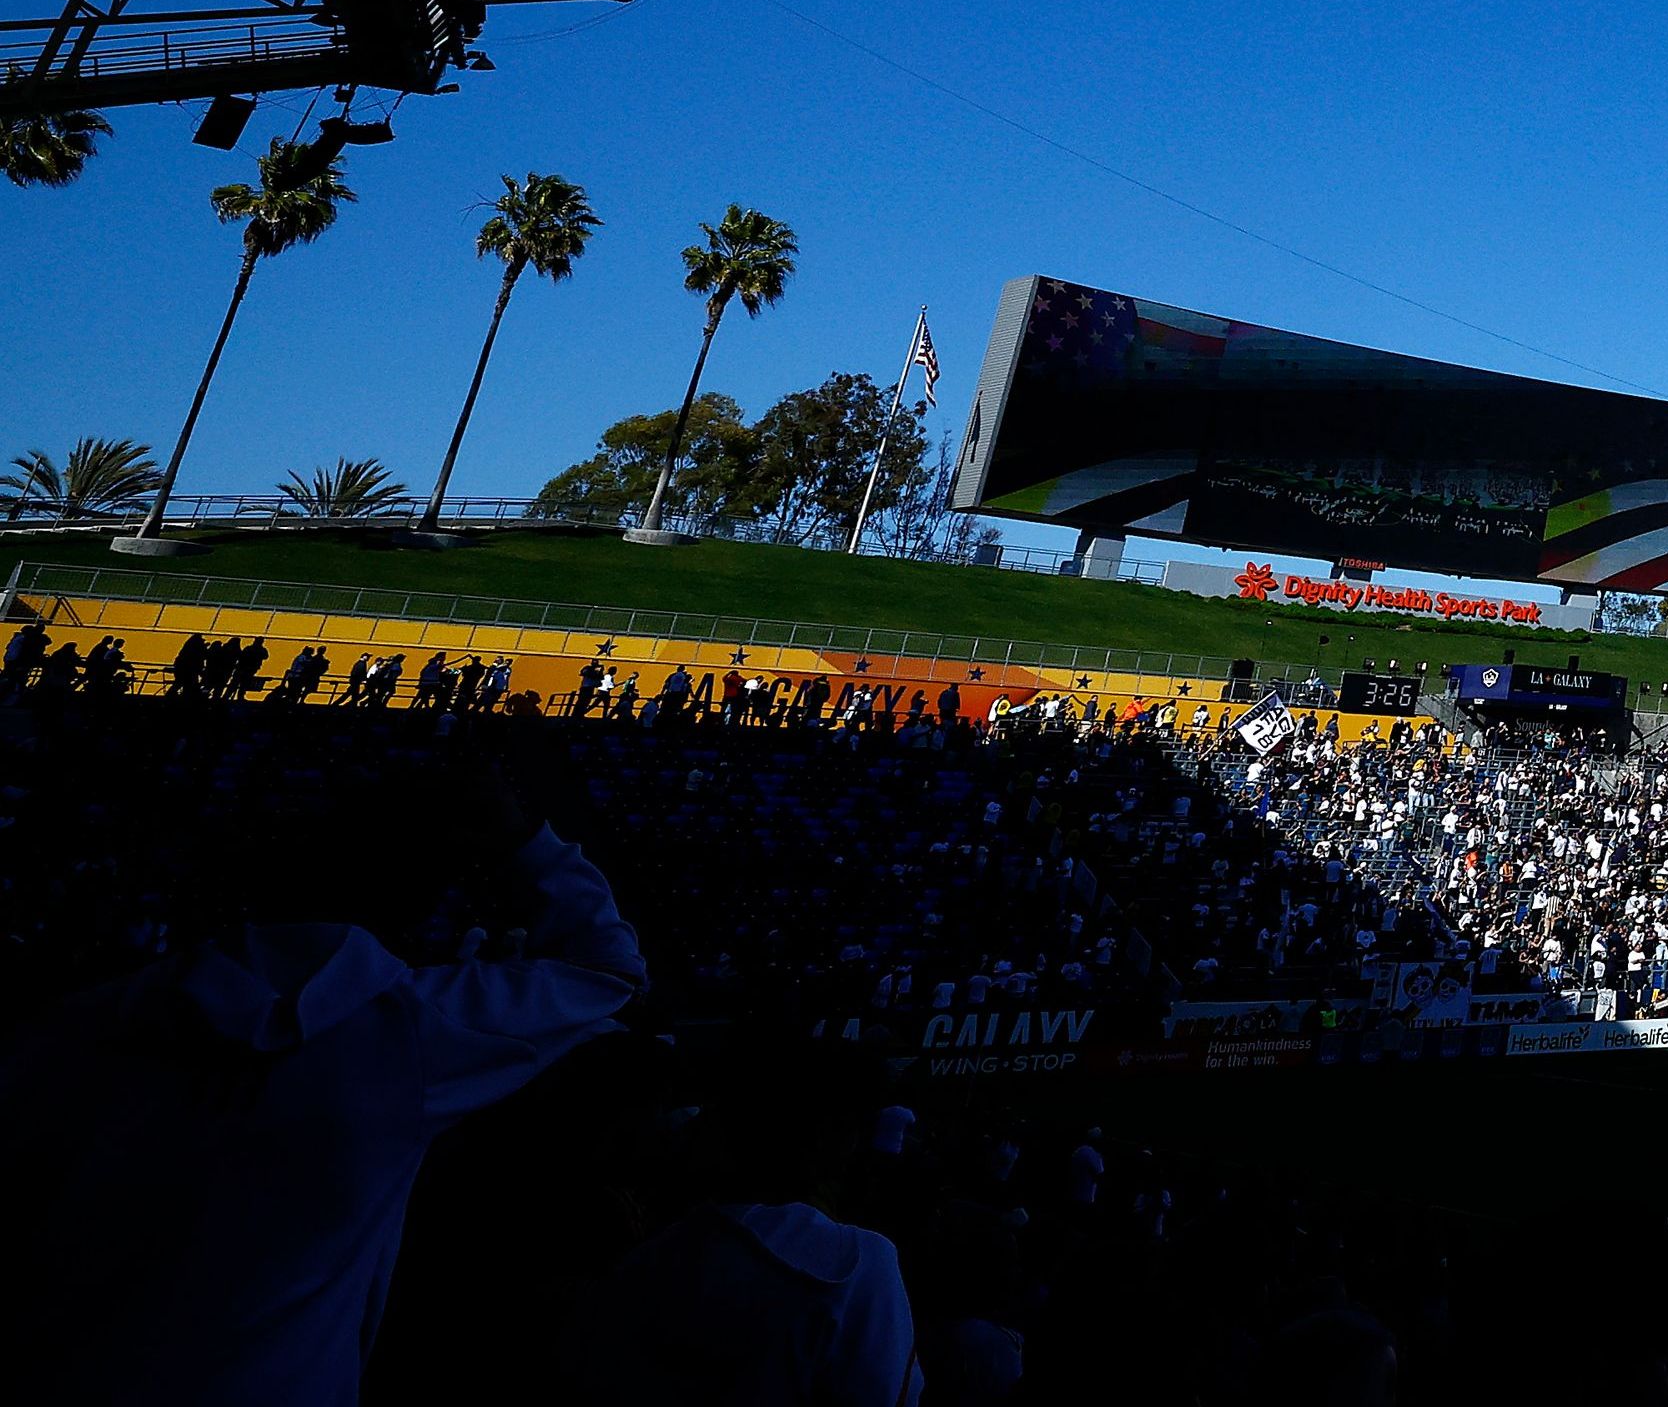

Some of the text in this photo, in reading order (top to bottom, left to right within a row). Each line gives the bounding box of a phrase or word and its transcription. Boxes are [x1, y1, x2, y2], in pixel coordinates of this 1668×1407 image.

[1343, 557, 1386, 571] TOSHIBA
[1284, 576, 1542, 624] Dignity Health Sports Park
[1531, 671, 1593, 689] LA GALAXY
[1366, 682, 1412, 707] 3:26
[1208, 1039, 1313, 1055] Humankindness
[1511, 1029, 1582, 1051] Herbalife
[1205, 1056, 1224, 1069] for
[1228, 1055, 1248, 1067] the
